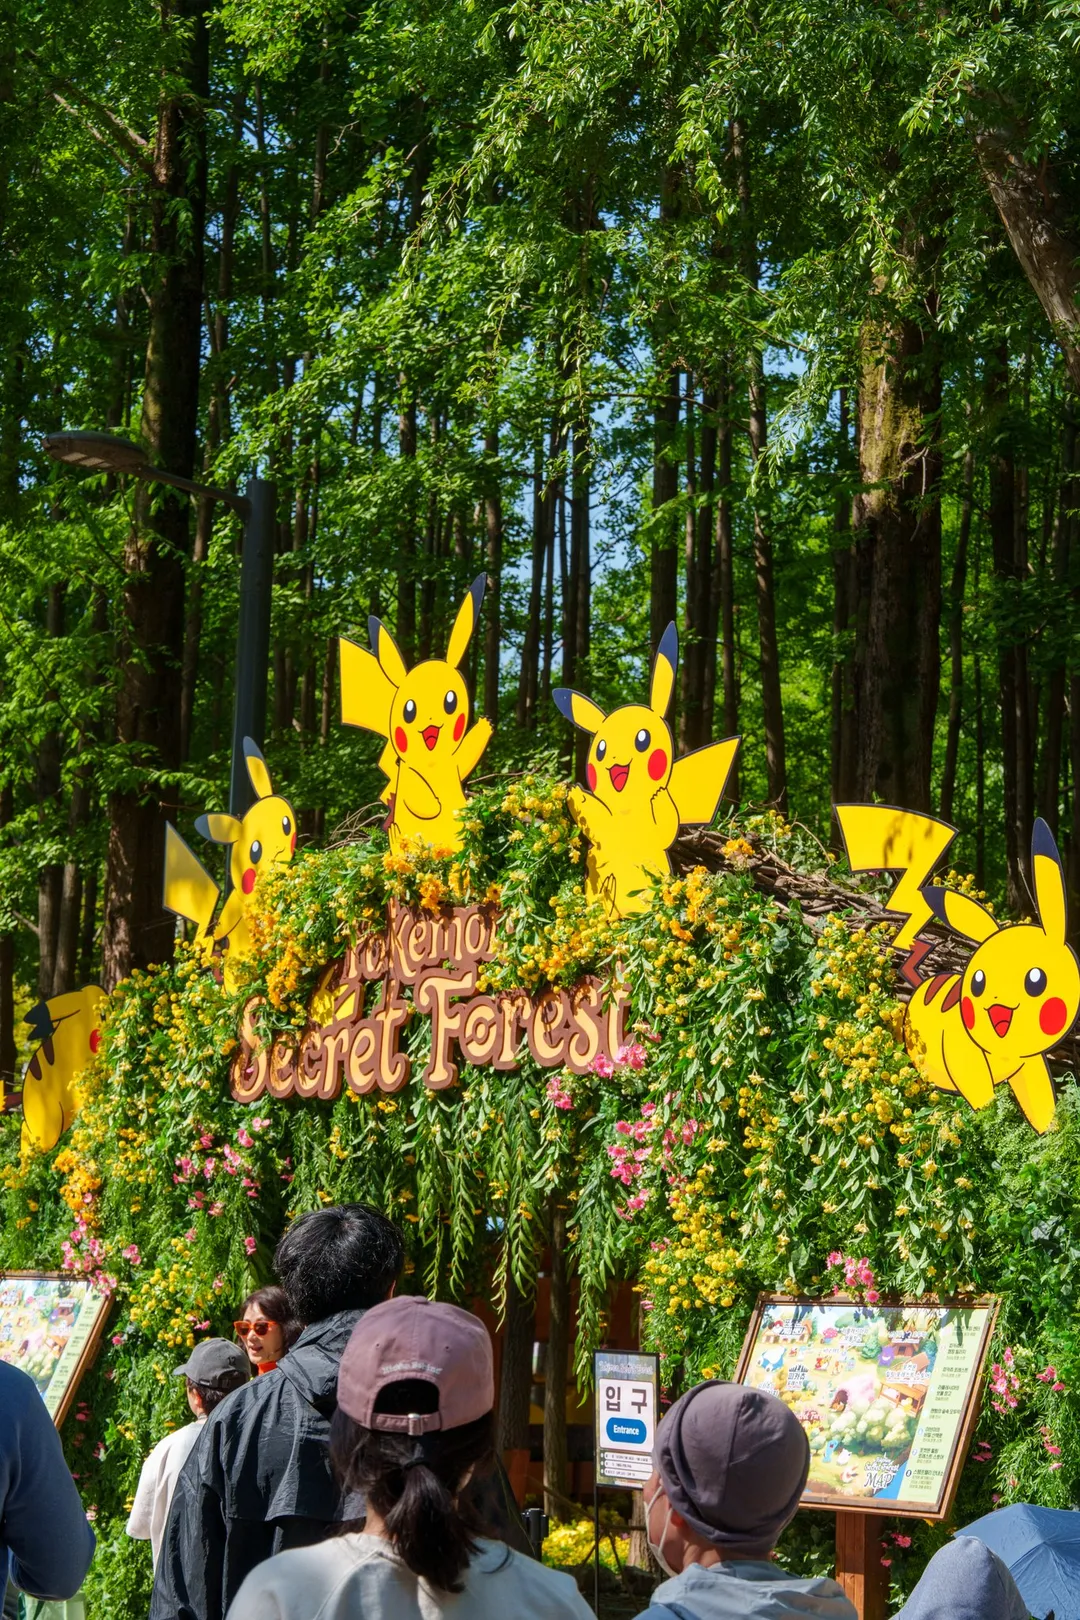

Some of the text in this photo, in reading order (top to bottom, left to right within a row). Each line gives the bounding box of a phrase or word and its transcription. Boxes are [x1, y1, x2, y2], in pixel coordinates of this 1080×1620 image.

[232, 960, 630, 1097] Secret Forest
[613, 1424, 640, 1436] Entrance
[863, 1471, 893, 1489] MAP
